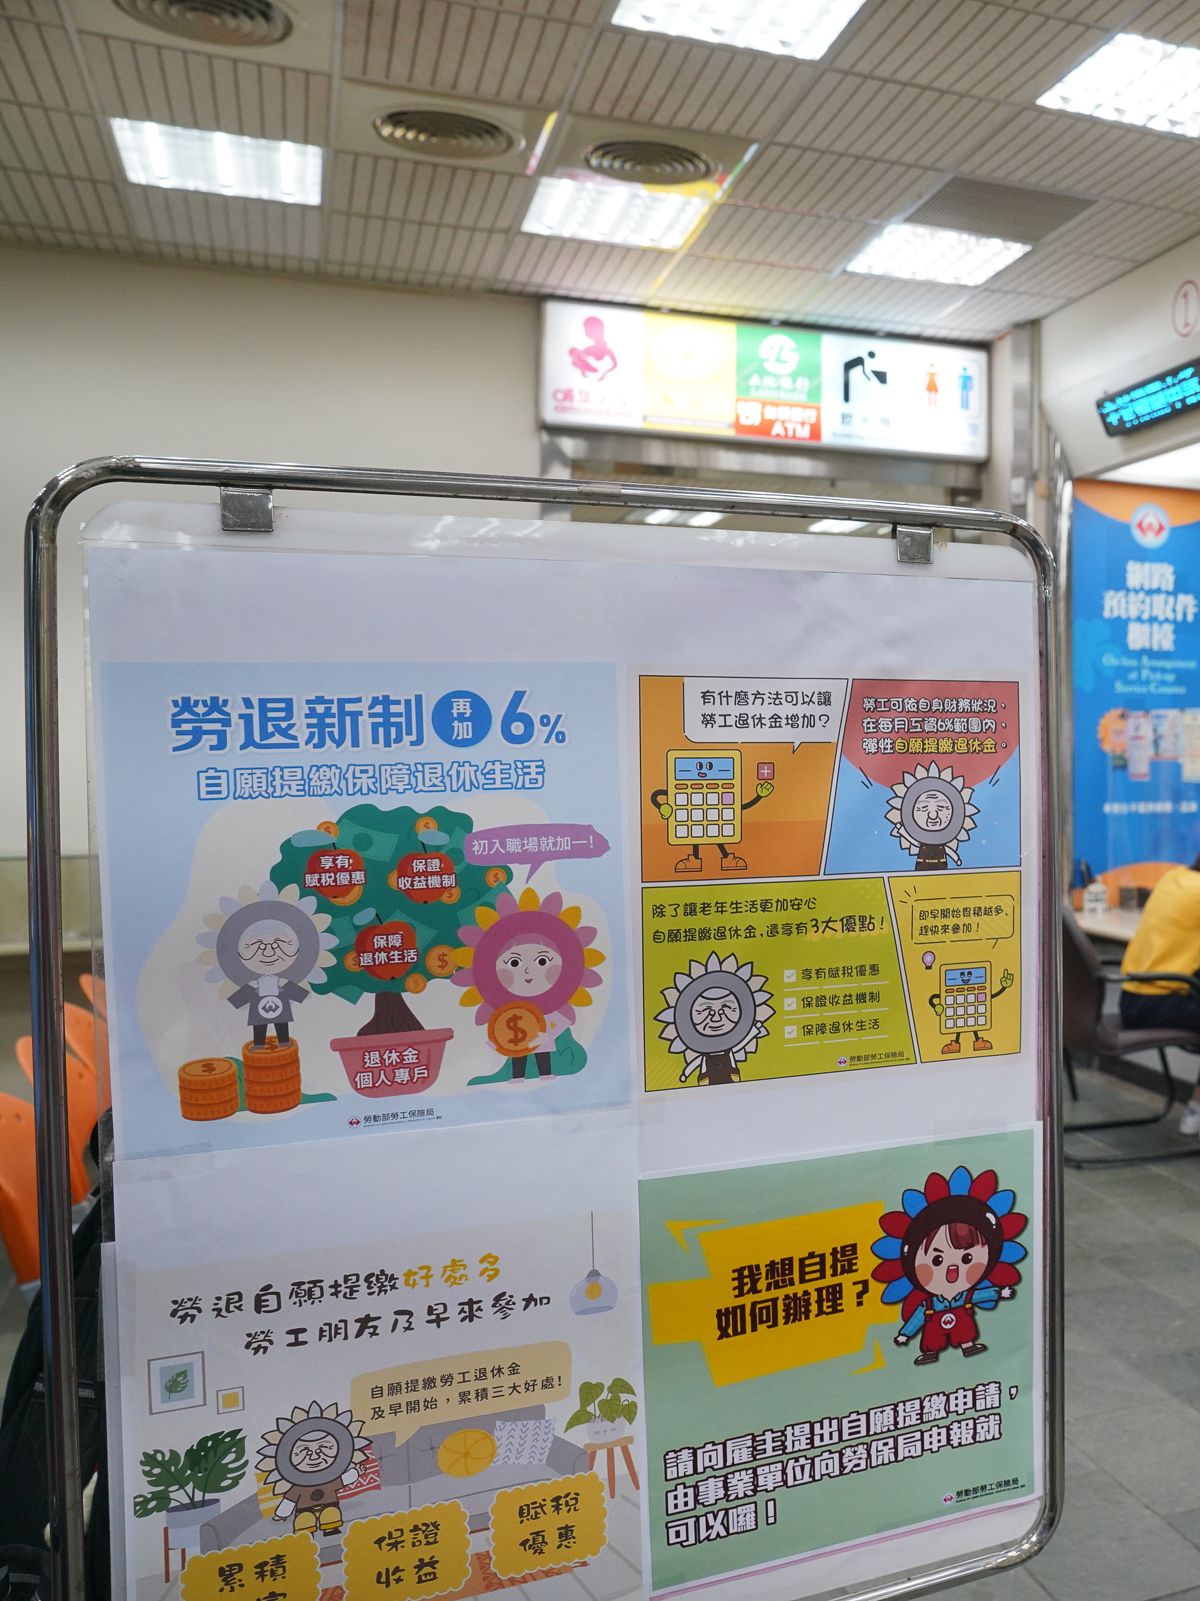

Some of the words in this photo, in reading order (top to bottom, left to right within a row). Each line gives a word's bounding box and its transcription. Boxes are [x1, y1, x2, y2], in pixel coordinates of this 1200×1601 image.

[170, 693, 424, 753] 勞退新制
[500, 690, 566, 744] 6%
[197, 760, 545, 800] 自願提繳保障退休生活
[320, 854, 351, 870] 享有
[411, 857, 442, 873] 保證
[305, 870, 366, 888] 賦稅優惠
[398, 873, 456, 891] 收益機制
[652, 896, 818, 918] 除了讓老年生活更加安心
[373, 933, 403, 949] 保障
[359, 948, 419, 967] 退休生活
[801, 963, 881, 981] 享有賦稅優惠
[801, 990, 881, 1010] 保證收益機制
[801, 1018, 881, 1038] 保障退休生活
[363, 1048, 421, 1068] 退休金
[354, 1066, 430, 1090] 個人專戶
[363, 1107, 435, 1124] 勞動部勞工保險局
[730, 1242, 860, 1299] 我想自提
[244, 1291, 551, 1357] 勞工朋友及早來參加
[370, 1361, 522, 1400] 自願提繳勞工退休金
[665, 1412, 1003, 1518] 由事業單位向勞保局申報就
[518, 1491, 580, 1525] 賦稅
[373, 1520, 441, 1552] 保證
[519, 1526, 578, 1558] 優惠
[218, 1553, 288, 1593] 累積
[375, 1554, 440, 1590] 收益
